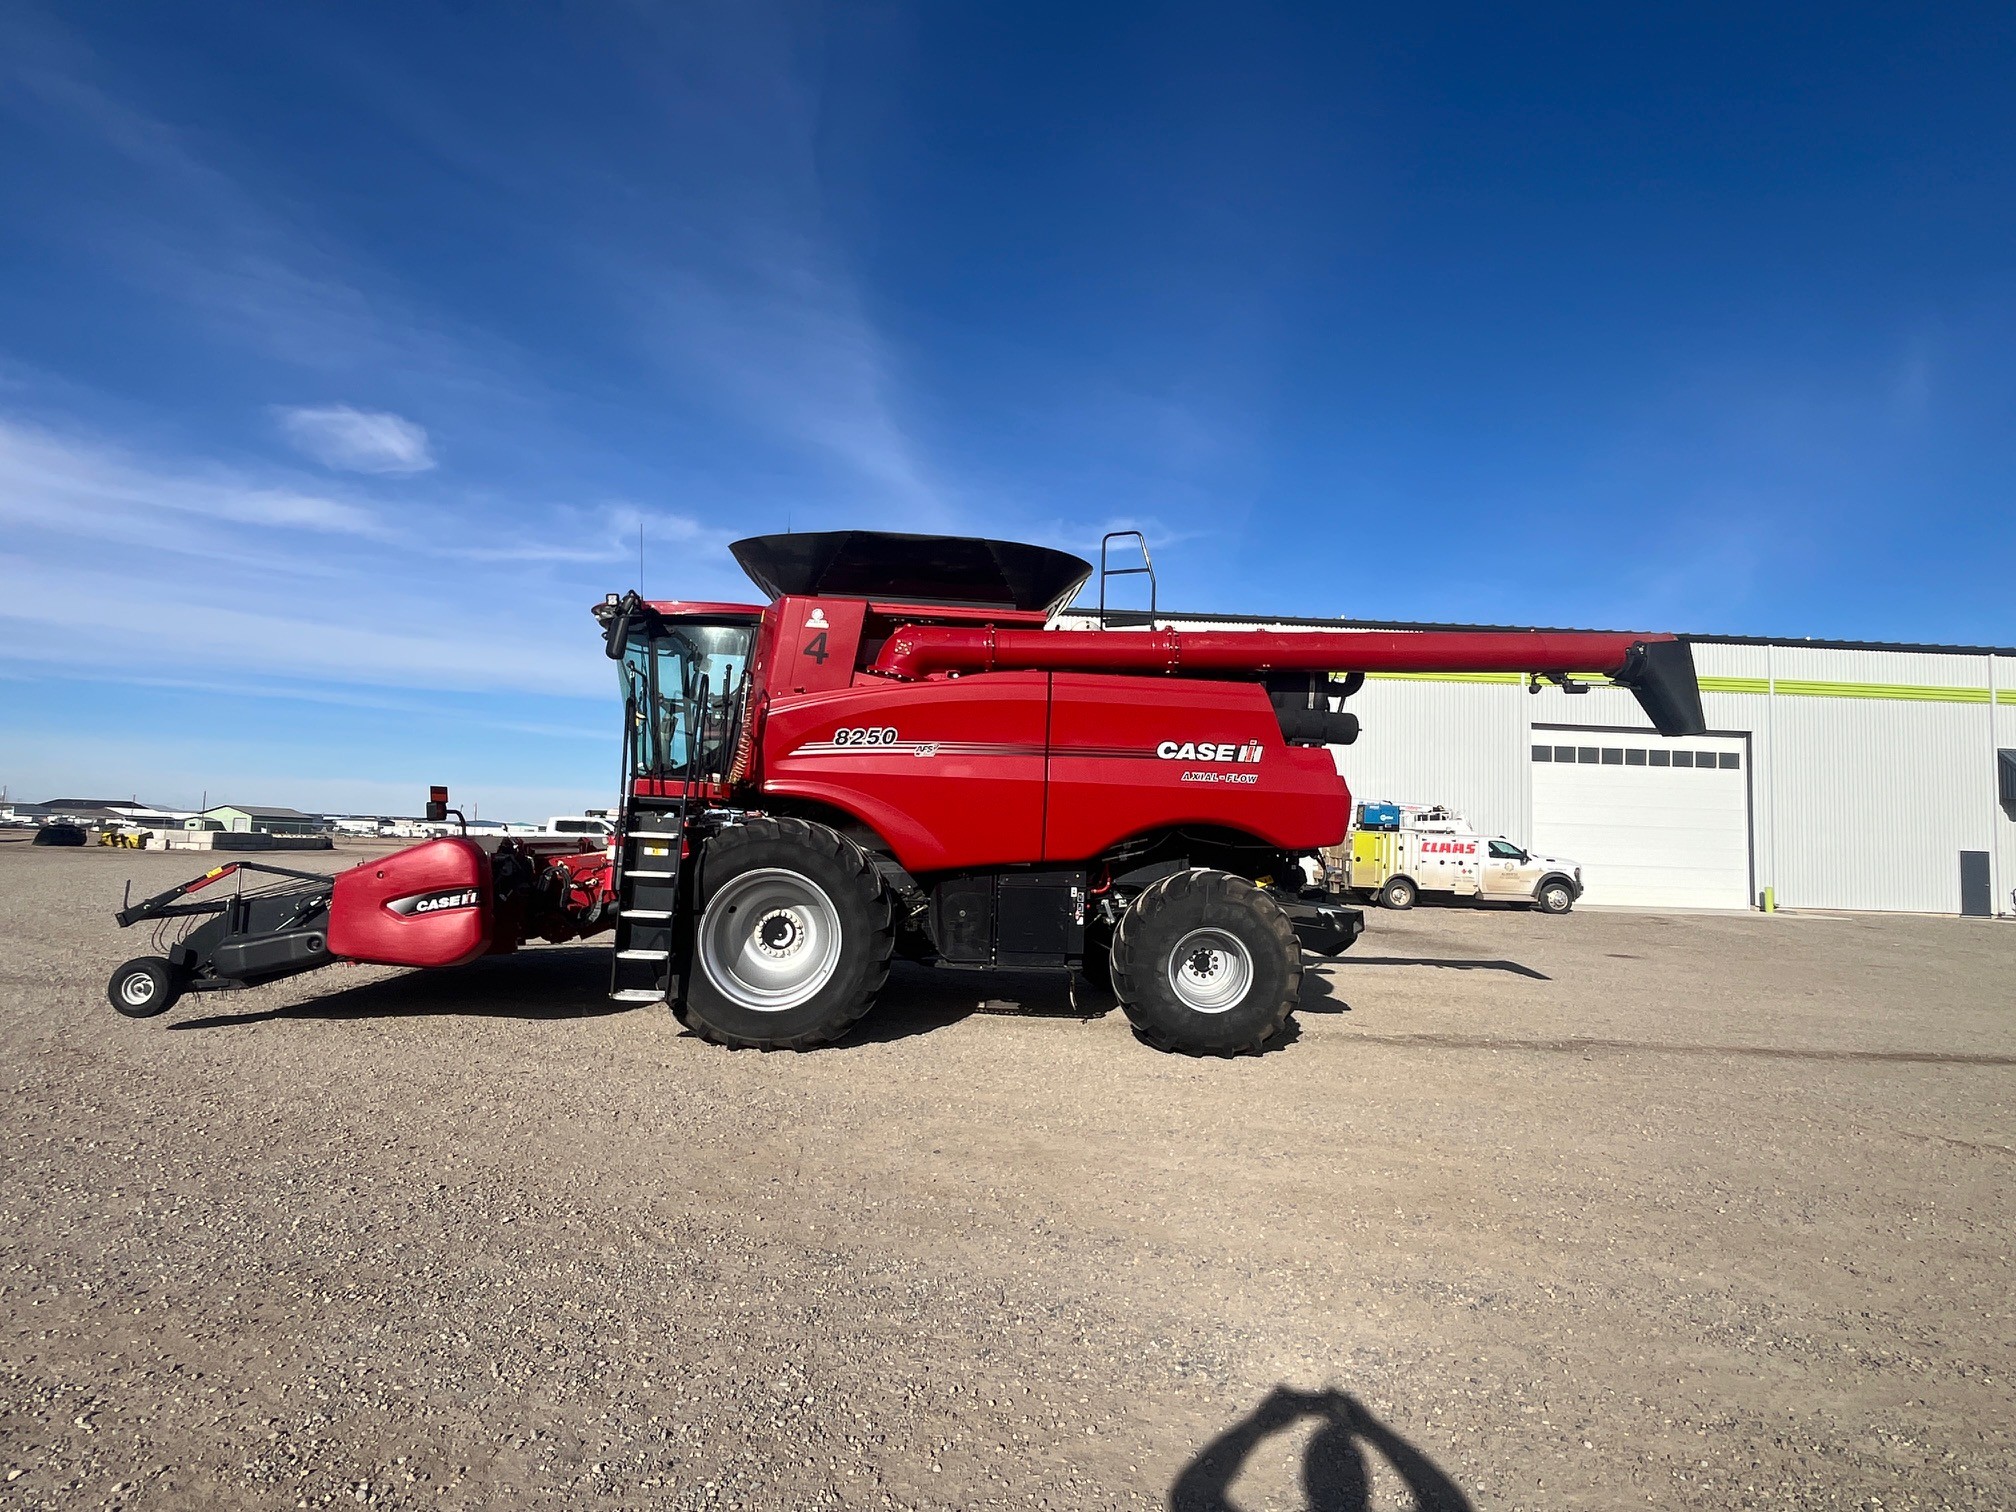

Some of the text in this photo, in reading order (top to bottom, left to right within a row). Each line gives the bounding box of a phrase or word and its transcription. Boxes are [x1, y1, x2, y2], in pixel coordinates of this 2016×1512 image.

[803, 633, 829, 664] 4
[834, 728, 897, 746] 8250
[916, 745, 934, 753] AFS
[1157, 741, 1235, 761] CASE
[1421, 842, 1476, 854] CLAAS
[416, 895, 461, 912] CASE
